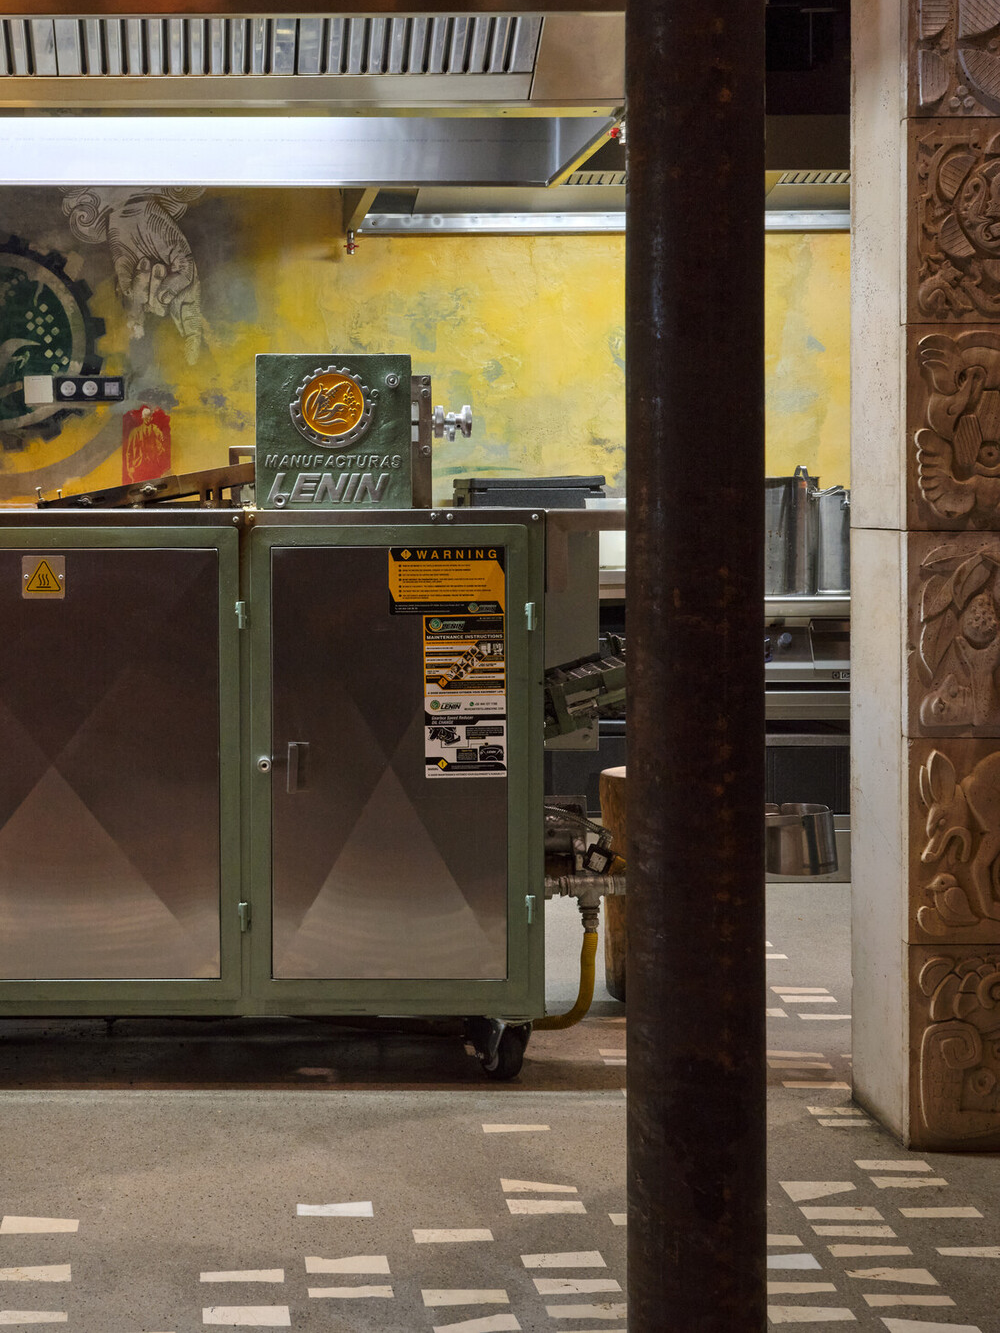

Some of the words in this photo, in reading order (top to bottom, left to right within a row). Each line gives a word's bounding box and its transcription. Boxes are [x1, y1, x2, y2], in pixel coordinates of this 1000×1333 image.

[264, 454, 402, 469] MANUFACTURAS
[266, 473, 391, 503] LENIN
[416, 549, 497, 560] WARNING
